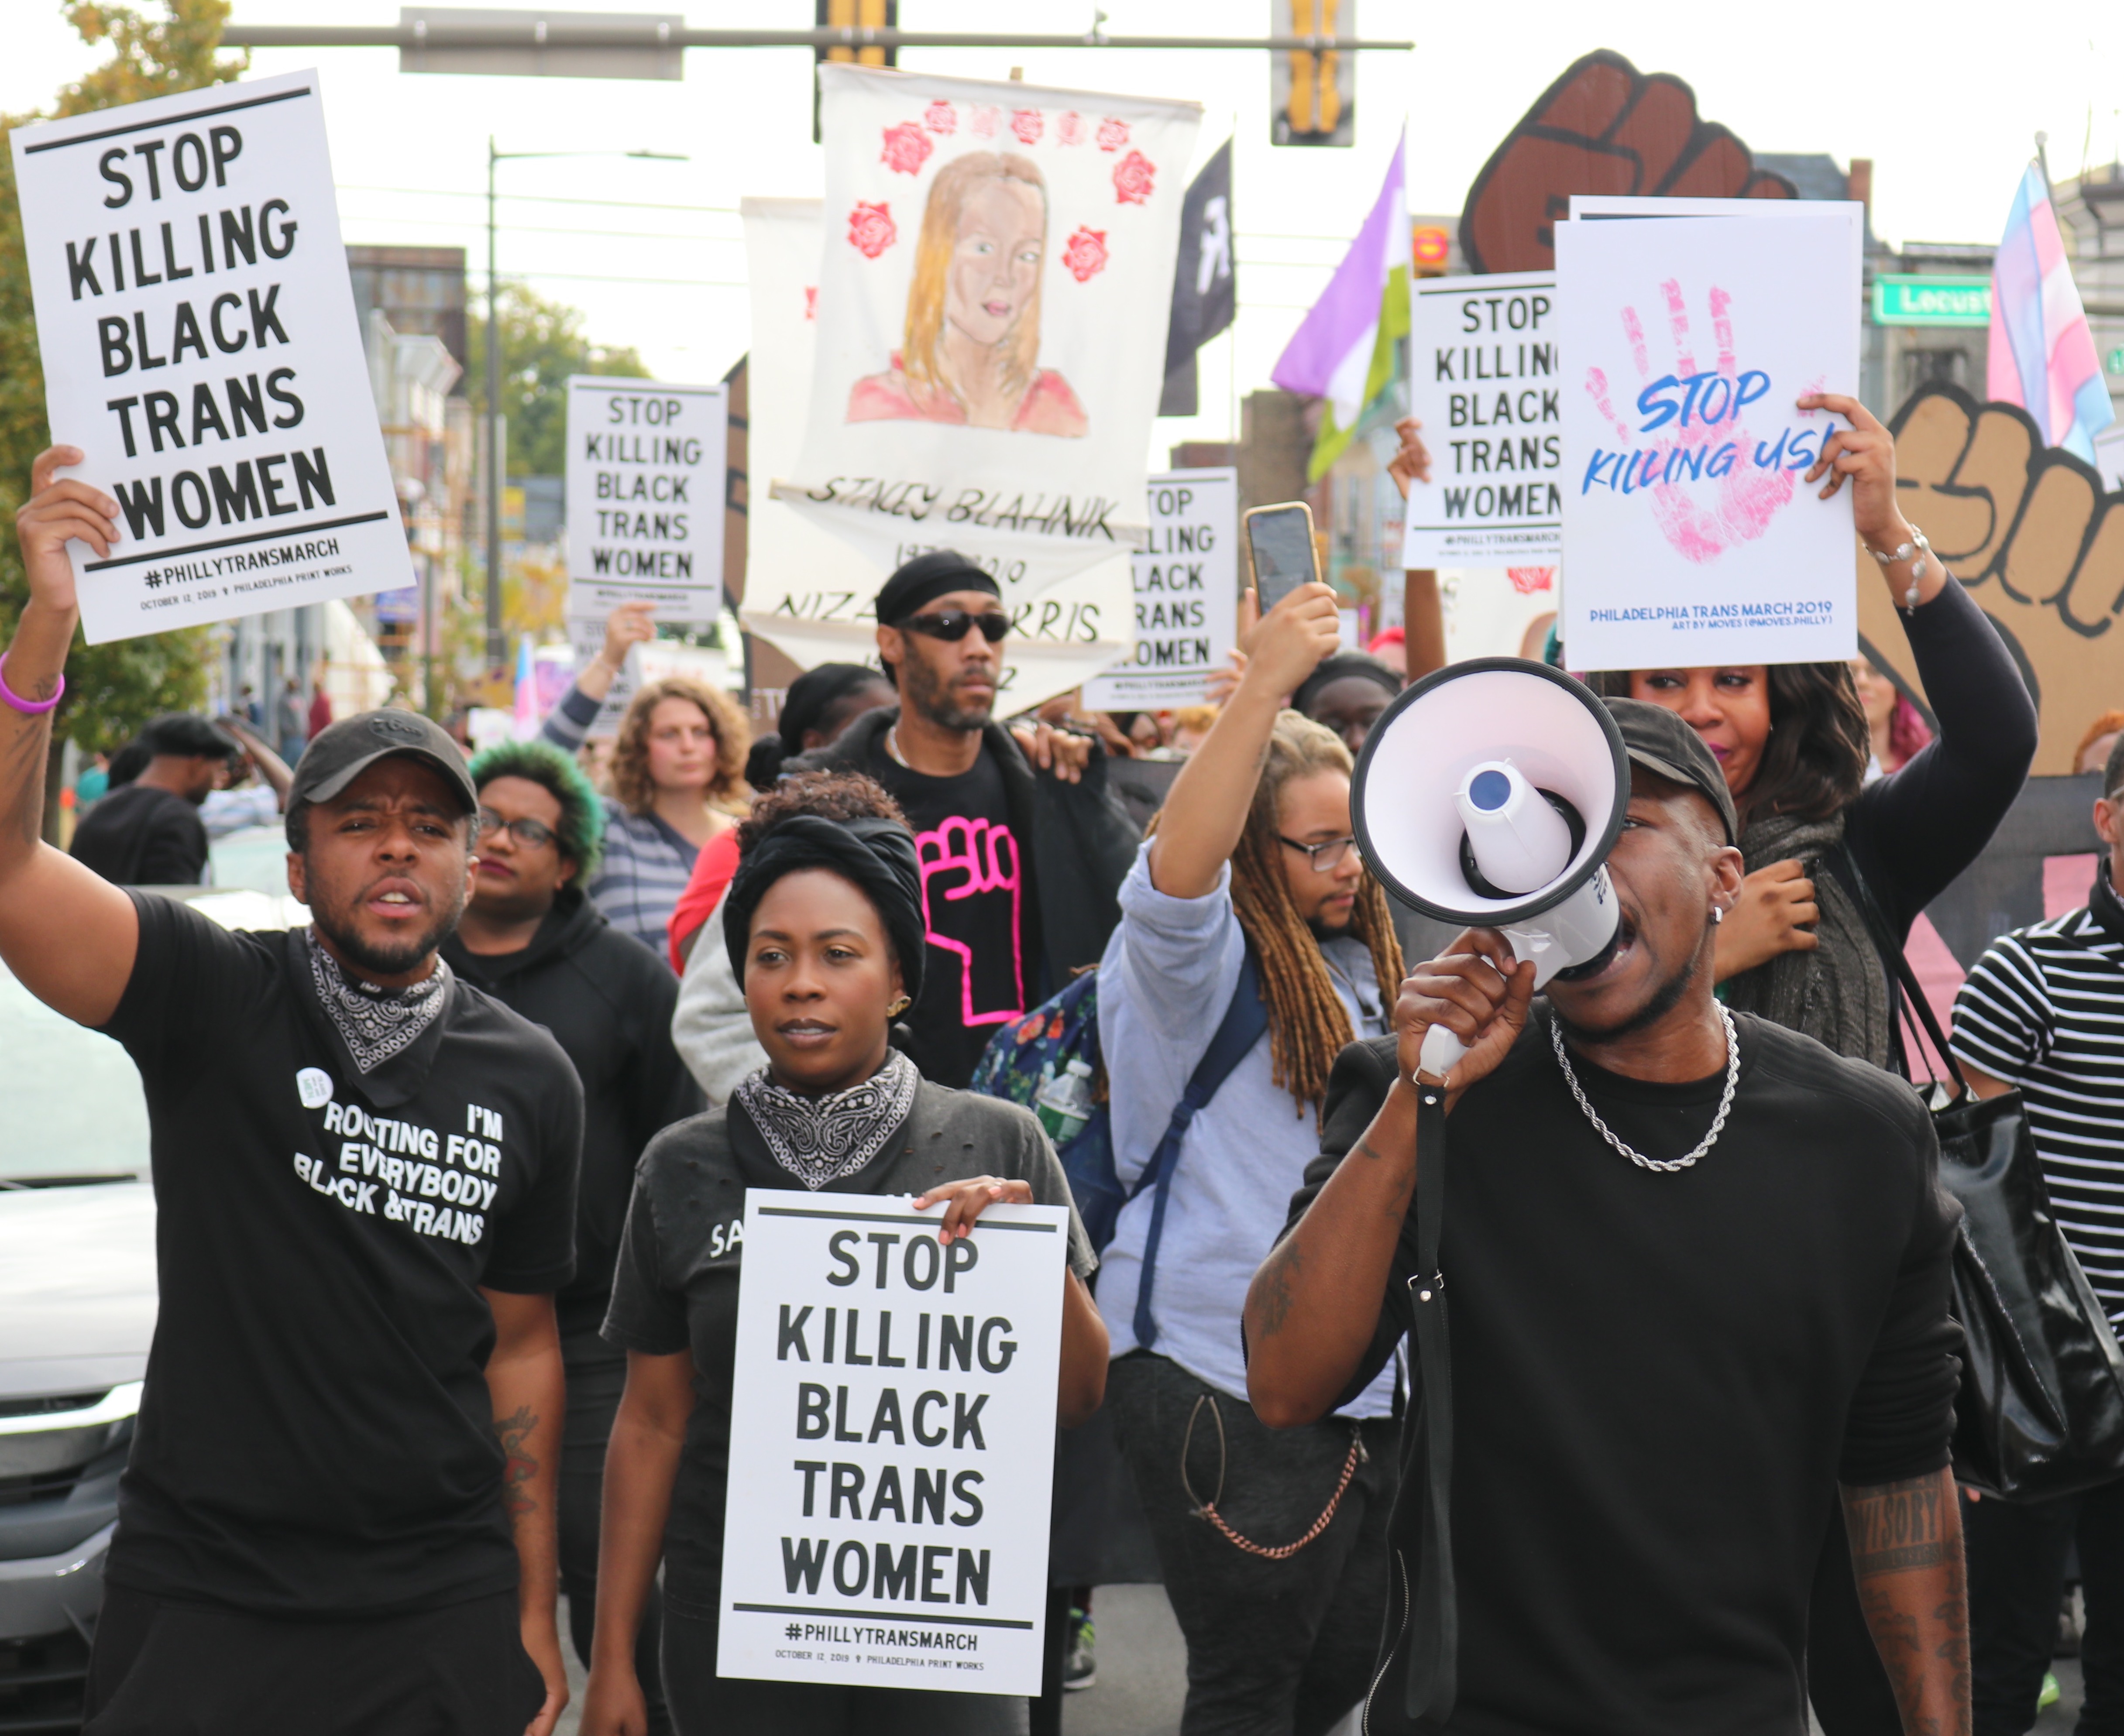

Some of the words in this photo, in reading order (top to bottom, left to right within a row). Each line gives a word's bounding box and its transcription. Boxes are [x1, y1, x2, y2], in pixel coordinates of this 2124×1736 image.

[99, 125, 243, 209] STOP
[65, 199, 298, 301] KILLING
[97, 284, 290, 378] BLACK
[1462, 295, 1551, 334] STOP
[1436, 342, 1558, 382] KILLIN
[107, 367, 305, 458] TRANS
[609, 397, 681, 426] STOP
[1449, 389, 1560, 428] BLACK
[1636, 370, 1772, 434] STOP
[586, 435, 701, 466] KILLING
[1449, 435, 1561, 474] TRANS
[1581, 443, 1736, 496] KILLING
[113, 447, 336, 541] WOMEN
[596, 472, 687, 503] BLACK
[1147, 487, 1193, 516] OP
[597, 510, 688, 541] TRANS
[1132, 525, 1214, 556] LING
[144, 538, 341, 589] #PHILLYTRANSMARCH
[592, 548, 693, 579] WOMEN
[1131, 564, 1203, 593] LACK
[141, 595, 179, 610] OCTOBER
[197, 590, 217, 601] 2019
[234, 575, 294, 593] PHILADELPHIA
[296, 570, 320, 583] PRINT
[323, 565, 352, 576] WORKS
[774, 591, 880, 623] NIZA
[1134, 600, 1205, 629] RANS
[1590, 606, 1688, 622] PHILADELPHIA
[1693, 604, 1739, 618] TRANS
[1742, 602, 1791, 616] MARCH
[1796, 600, 1833, 614] 2019
[1672, 619, 1691, 630] ART
[1693, 619, 1706, 629] BY
[1708, 618, 1743, 628] MOVES
[1112, 638, 1210, 668] OMEN
[446, 1134, 502, 1177] FOR
[709, 1219, 744, 1258] SA
[826, 1230, 980, 1294] STOP
[777, 1304, 1017, 1374] KILLING
[796, 1382, 990, 1451] BLACK
[794, 1460, 984, 1527] TRANS
[781, 1537, 990, 1606] WOMEN
[785, 1623, 977, 1651] #PHILLYTRANSMARCH
[775, 1650, 812, 1661] OCTOBER
[831, 1653, 849, 1663] 2019
[866, 1655, 925, 1667] PHILADELPHIA
[928, 1660, 952, 1669] PRINT
[956, 1661, 984, 1671] WORKS
